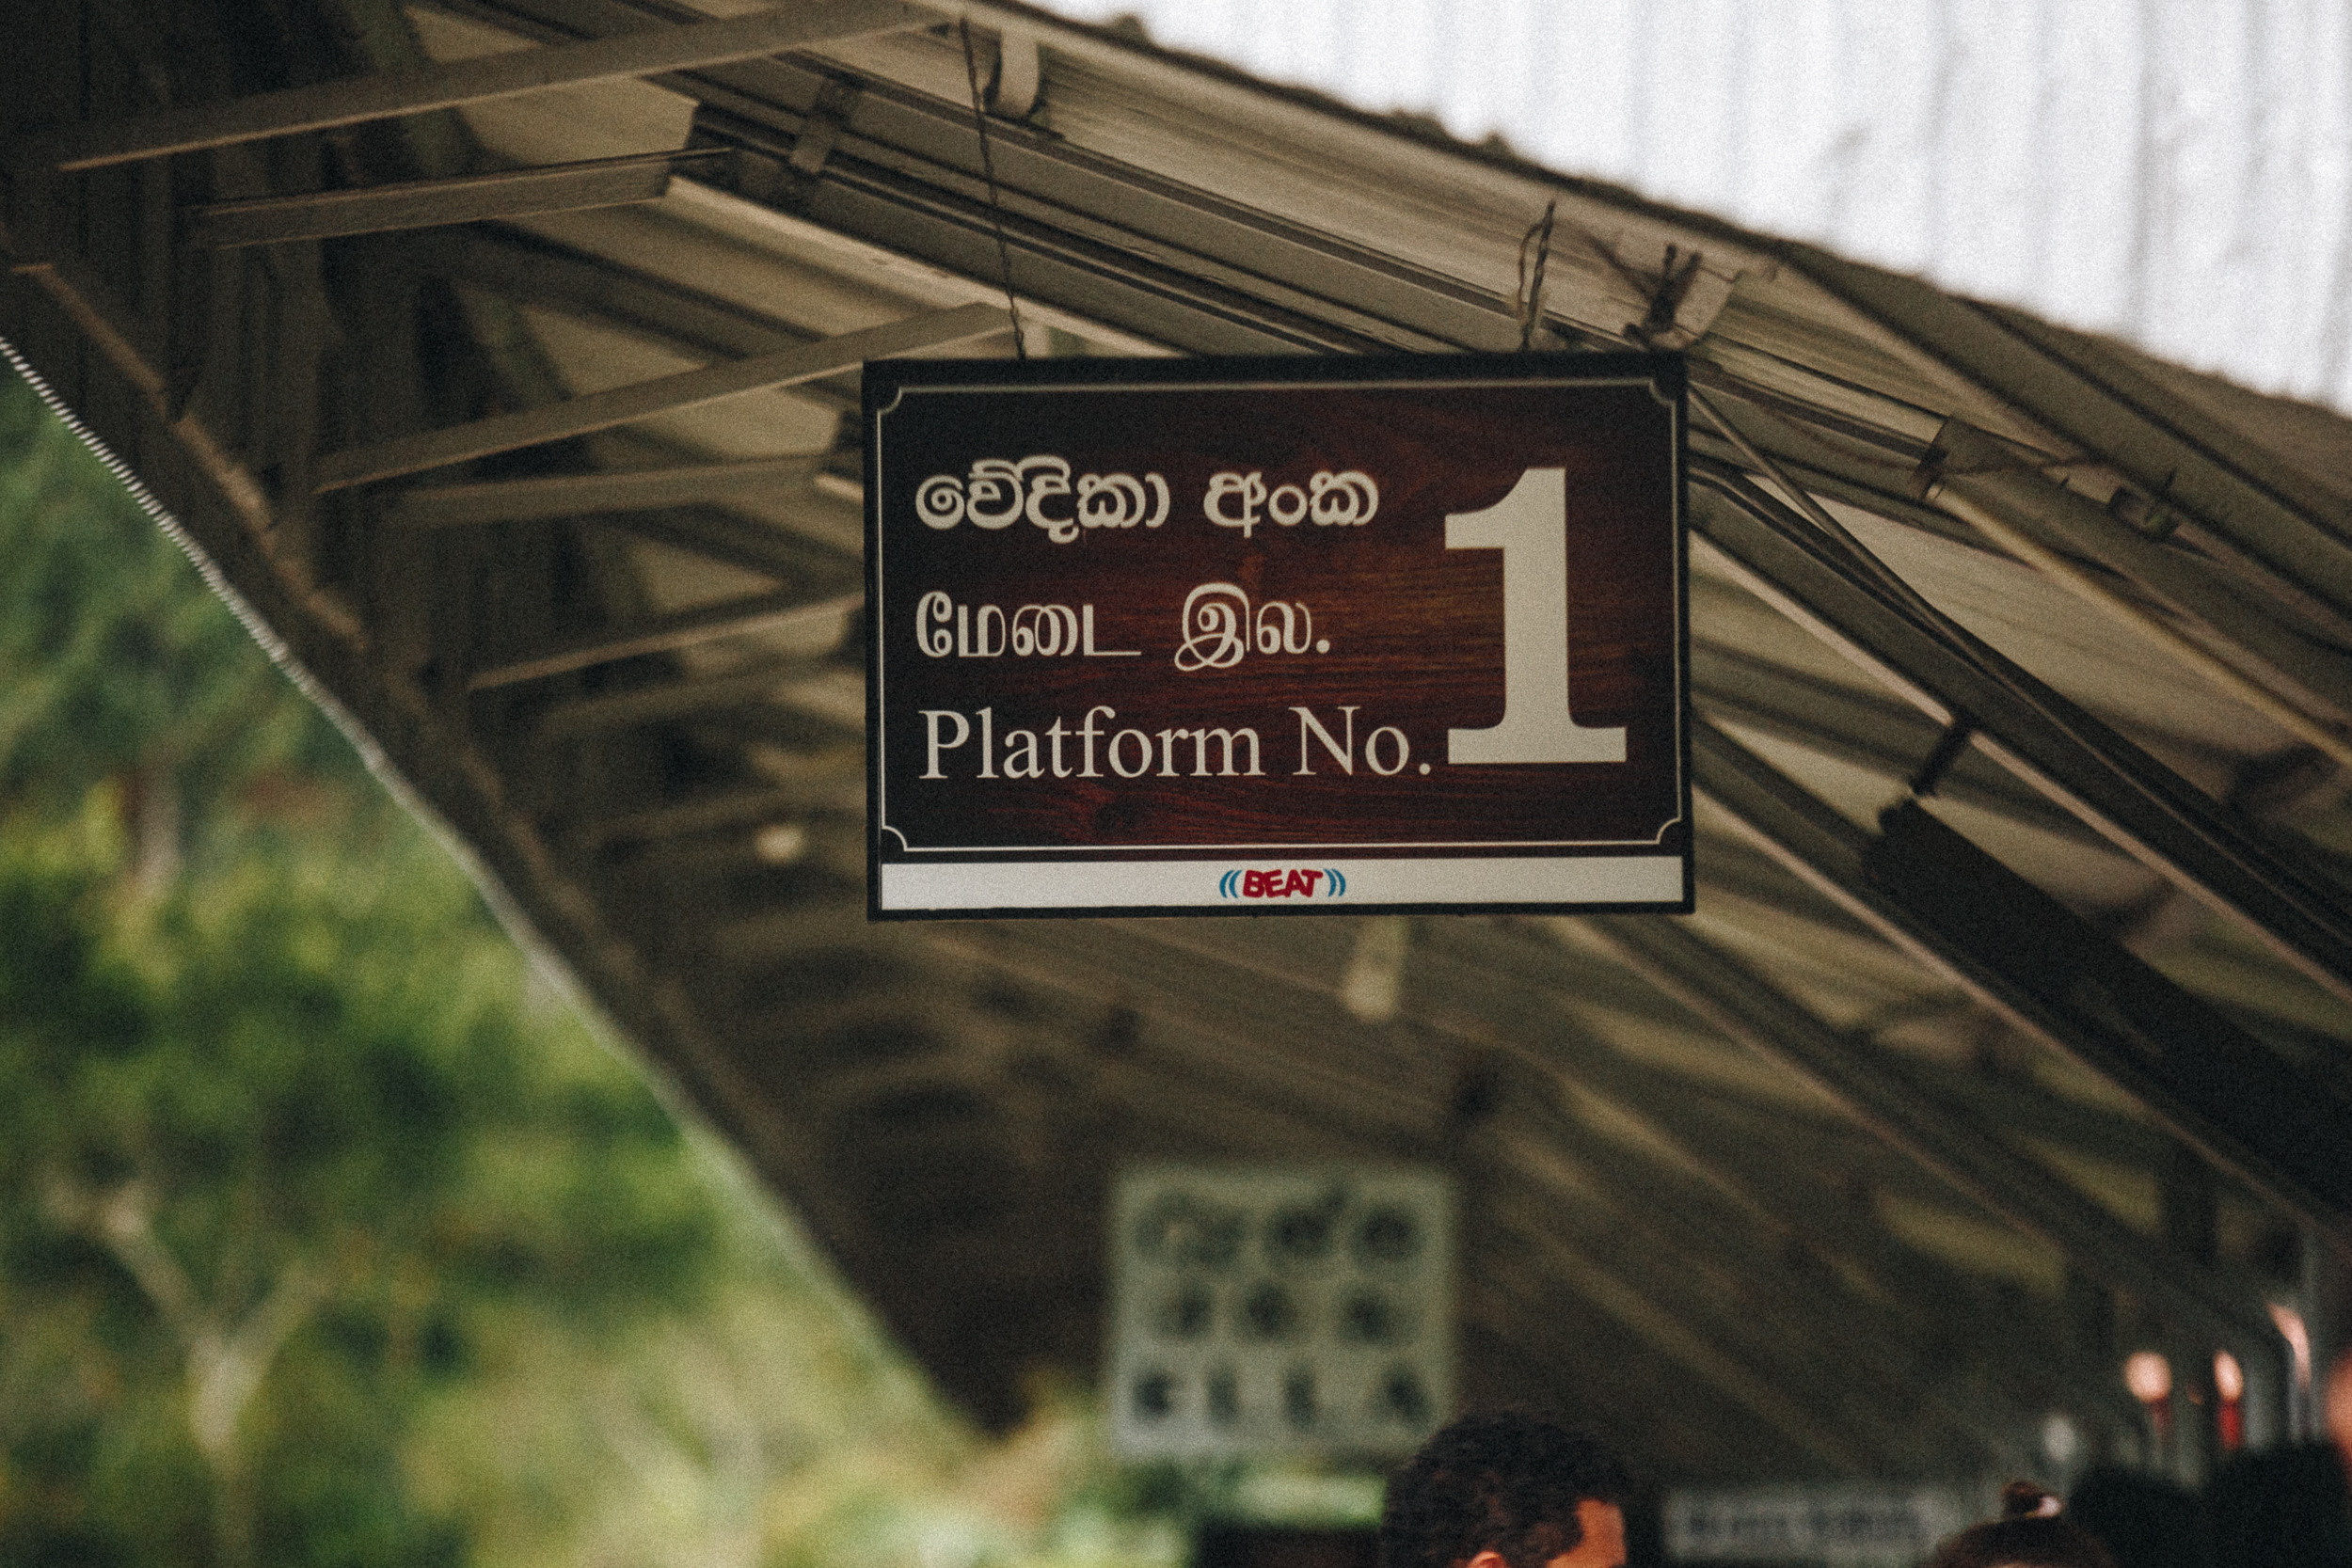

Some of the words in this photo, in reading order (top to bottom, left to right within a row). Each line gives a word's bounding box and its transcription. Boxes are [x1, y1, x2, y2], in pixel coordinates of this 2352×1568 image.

[915, 455, 1170, 544] වේදිකා
[1203, 469, 1379, 538] අංක
[916, 591, 1141, 657] மேடை
[1174, 582, 1330, 672] இல.
[1444, 467, 1627, 764] 1
[919, 705, 1265, 779] Platform
[1289, 705, 1431, 776] No.
[1242, 868, 1324, 898] BEAT
